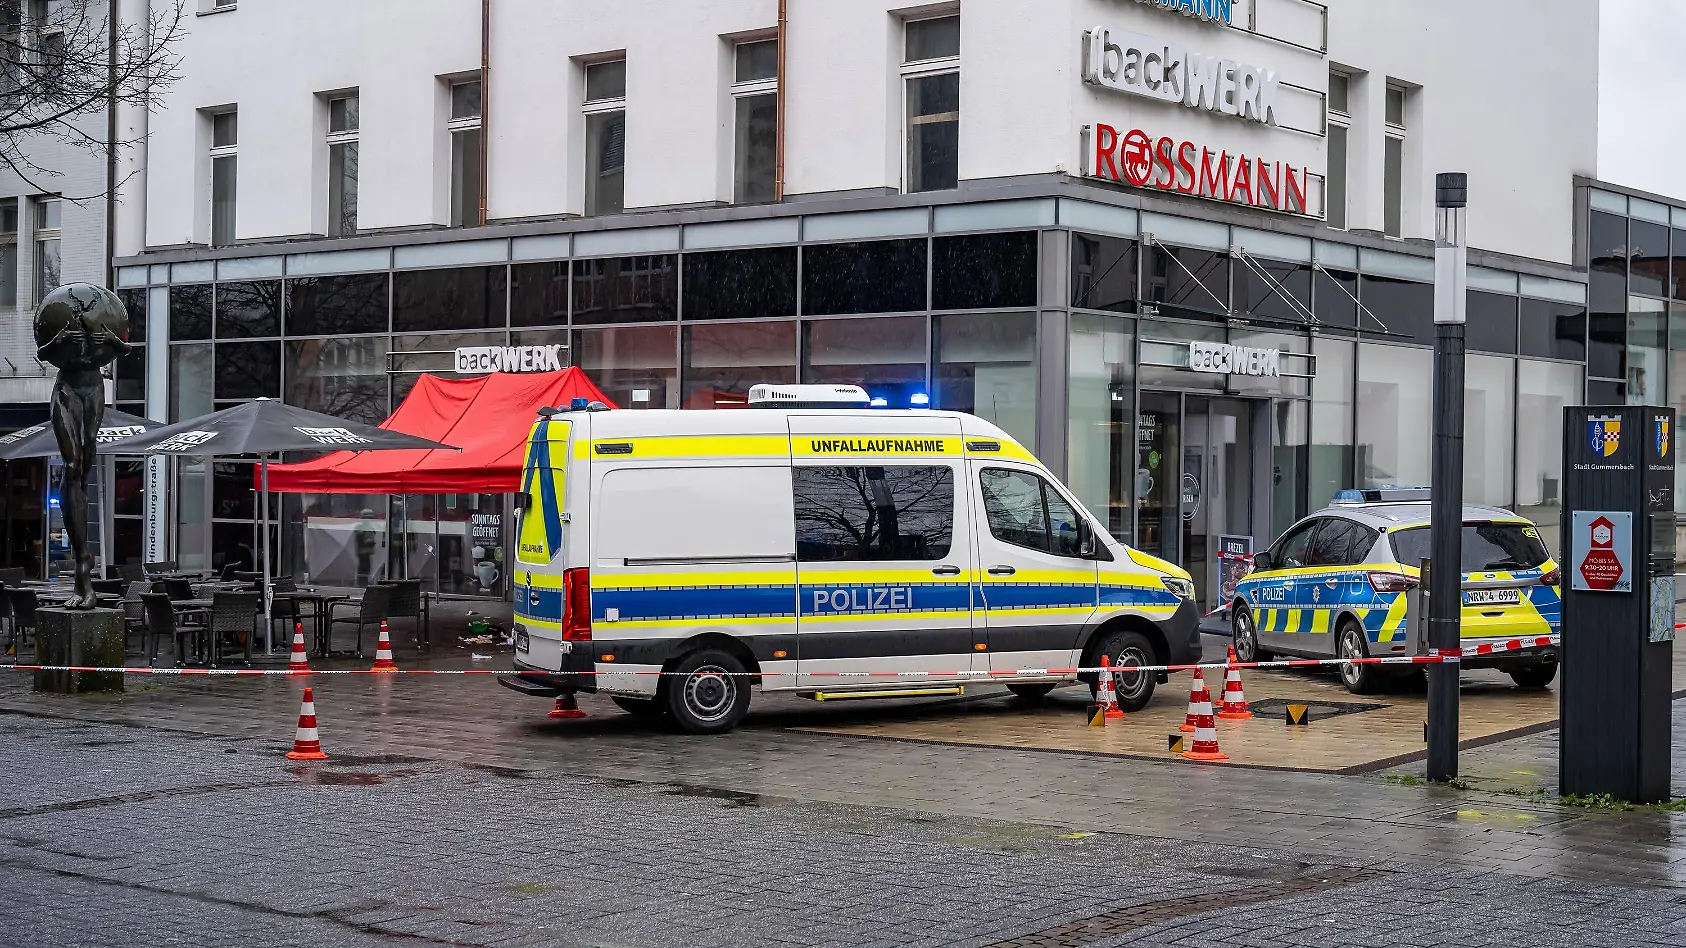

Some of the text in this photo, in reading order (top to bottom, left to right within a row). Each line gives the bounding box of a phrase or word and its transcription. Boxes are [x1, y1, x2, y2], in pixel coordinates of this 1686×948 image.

[1102, 28, 1280, 126] backWERK
[1096, 122, 1308, 214] ROSSMANN
[459, 344, 561, 373] backWERK
[1194, 343, 1280, 377] backWERK
[811, 440, 944, 452] UNFALLAUFNAHME
[471, 513, 501, 525] SONNTAGS
[472, 525, 499, 538] GEÖFFNET
[813, 587, 913, 612] POLIZEI
[1262, 587, 1285, 600] POLIZEI
[1468, 591, 1485, 602] NRW
